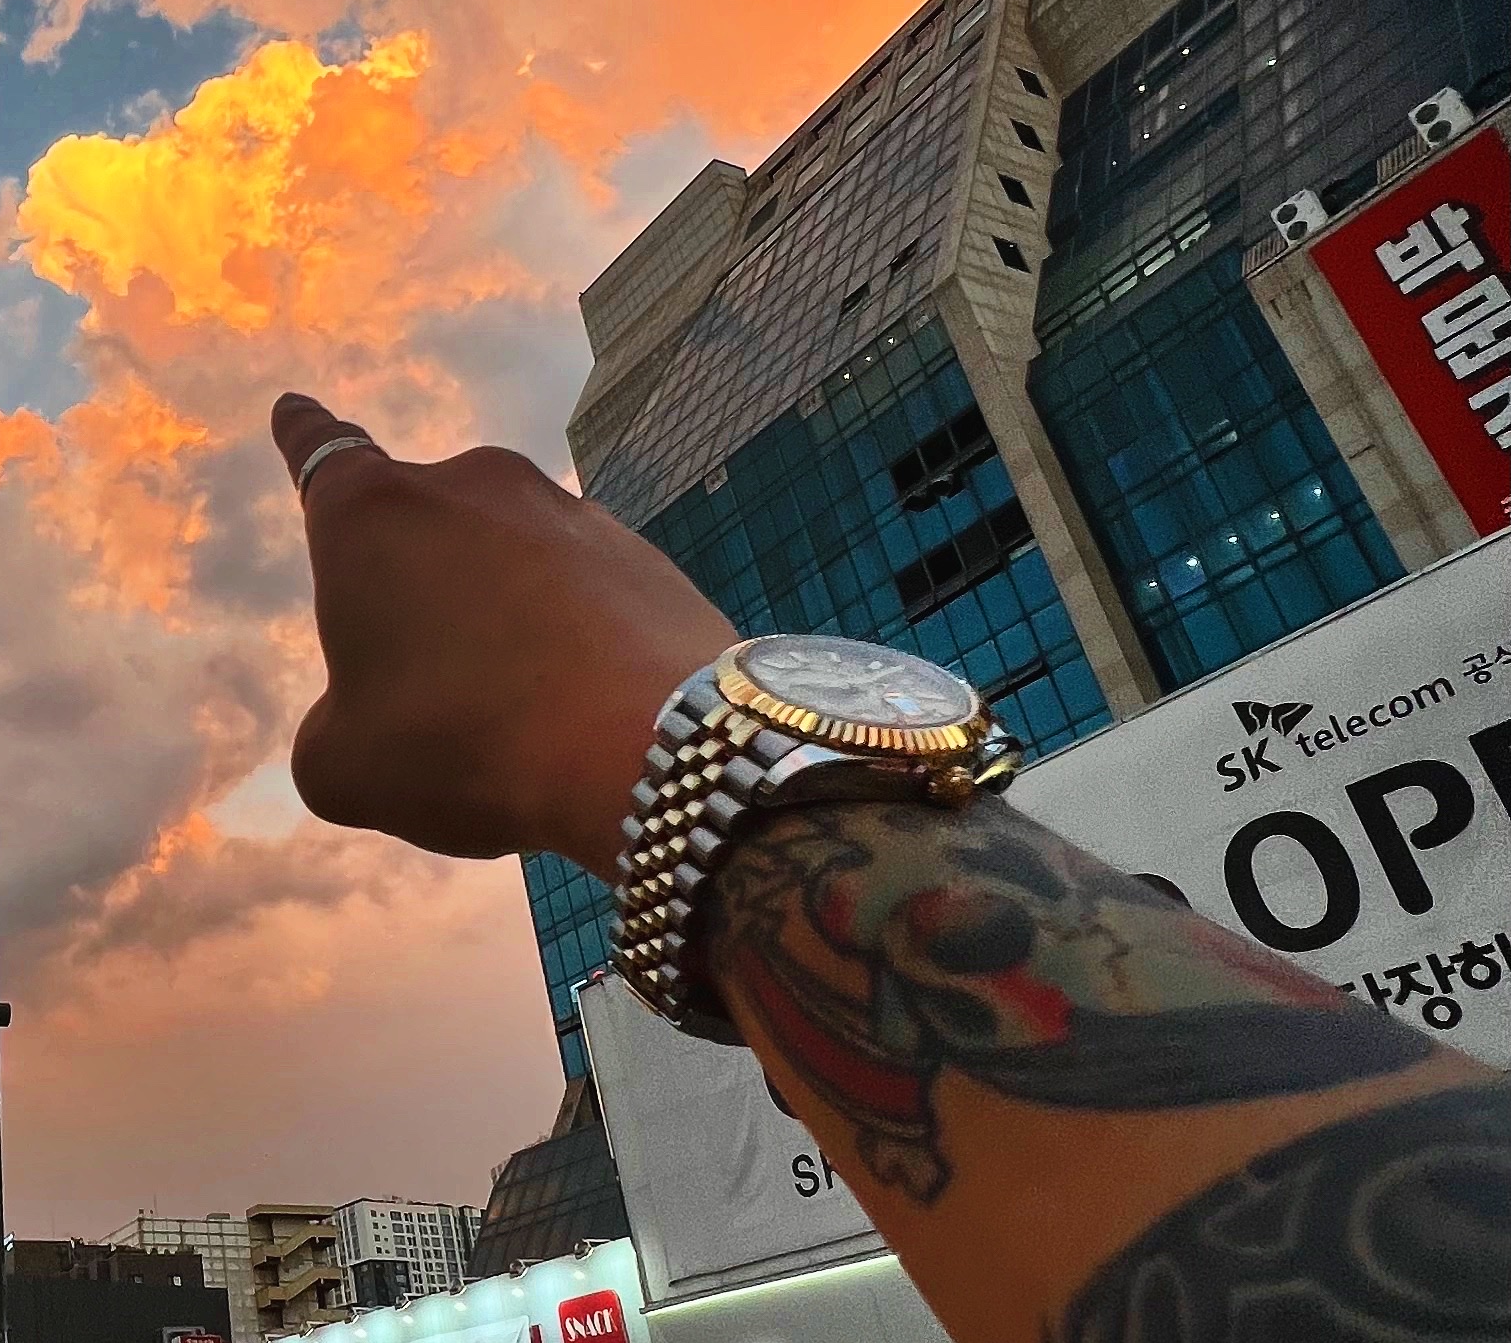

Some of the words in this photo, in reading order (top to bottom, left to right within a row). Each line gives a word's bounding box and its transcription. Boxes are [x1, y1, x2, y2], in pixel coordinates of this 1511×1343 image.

[1215, 736, 1284, 793] SK
[1294, 676, 1457, 758] telecom
[1223, 714, 1511, 954] OP
[565, 1307, 618, 1342] SNACK
